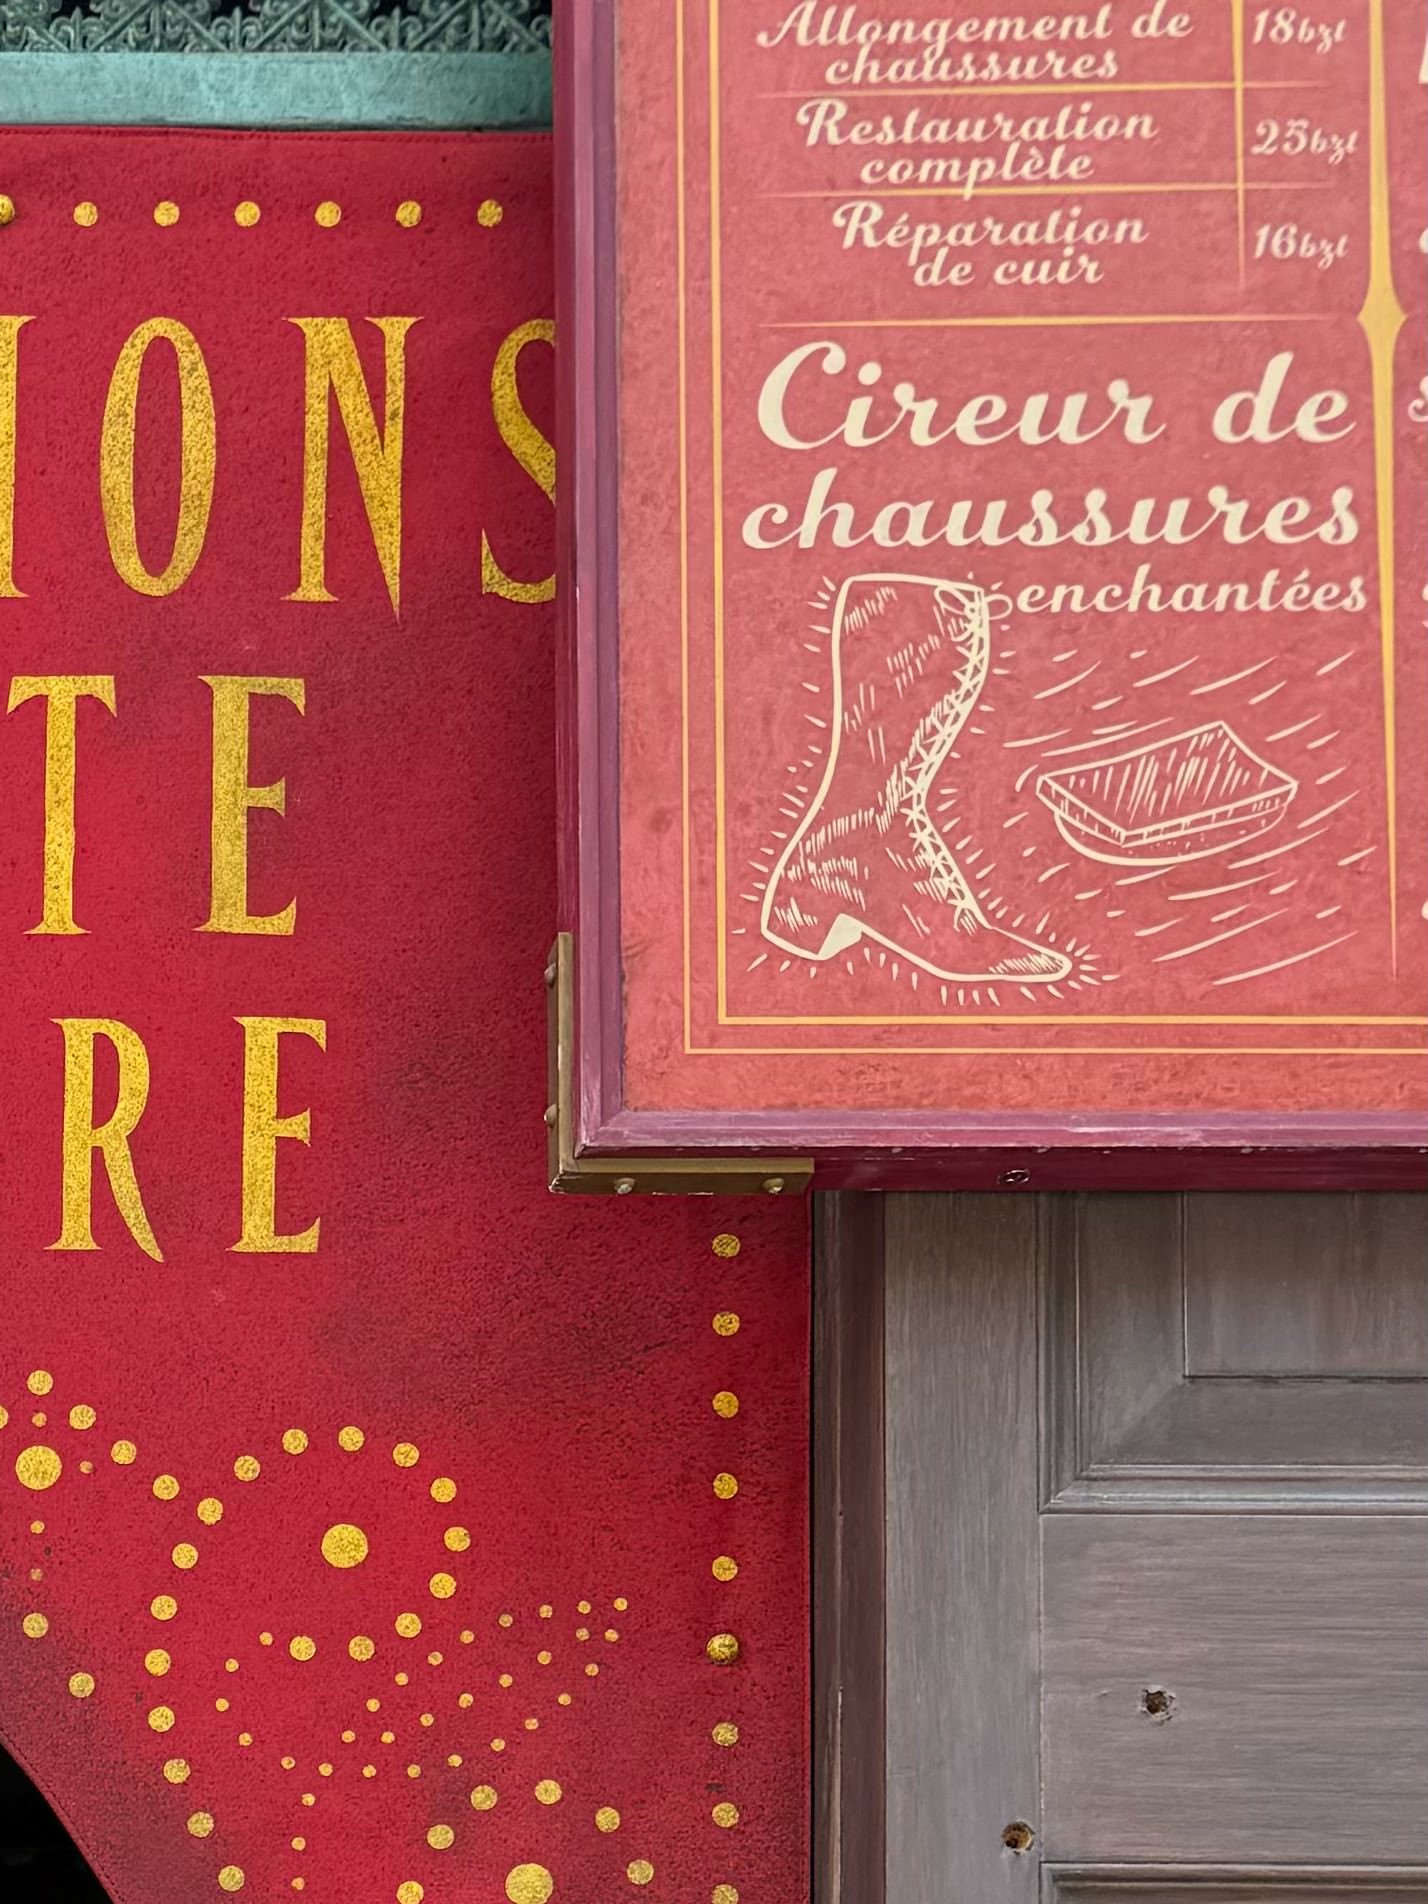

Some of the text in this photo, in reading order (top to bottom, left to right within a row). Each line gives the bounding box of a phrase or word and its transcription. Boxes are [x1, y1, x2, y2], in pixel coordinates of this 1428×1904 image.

[756, 0, 1193, 64] Allongement de
[824, 46, 1120, 86] chaussures
[796, 98, 1157, 148] Restauration
[860, 142, 1095, 200] complète
[832, 201, 1148, 266] Réparation
[913, 245, 1103, 287] de cuir
[757, 340, 1166, 450] Cireur
[1212, 351, 1356, 444] de
[742, 467, 1359, 549] chaussures
[1016, 563, 1367, 613] enchantées
